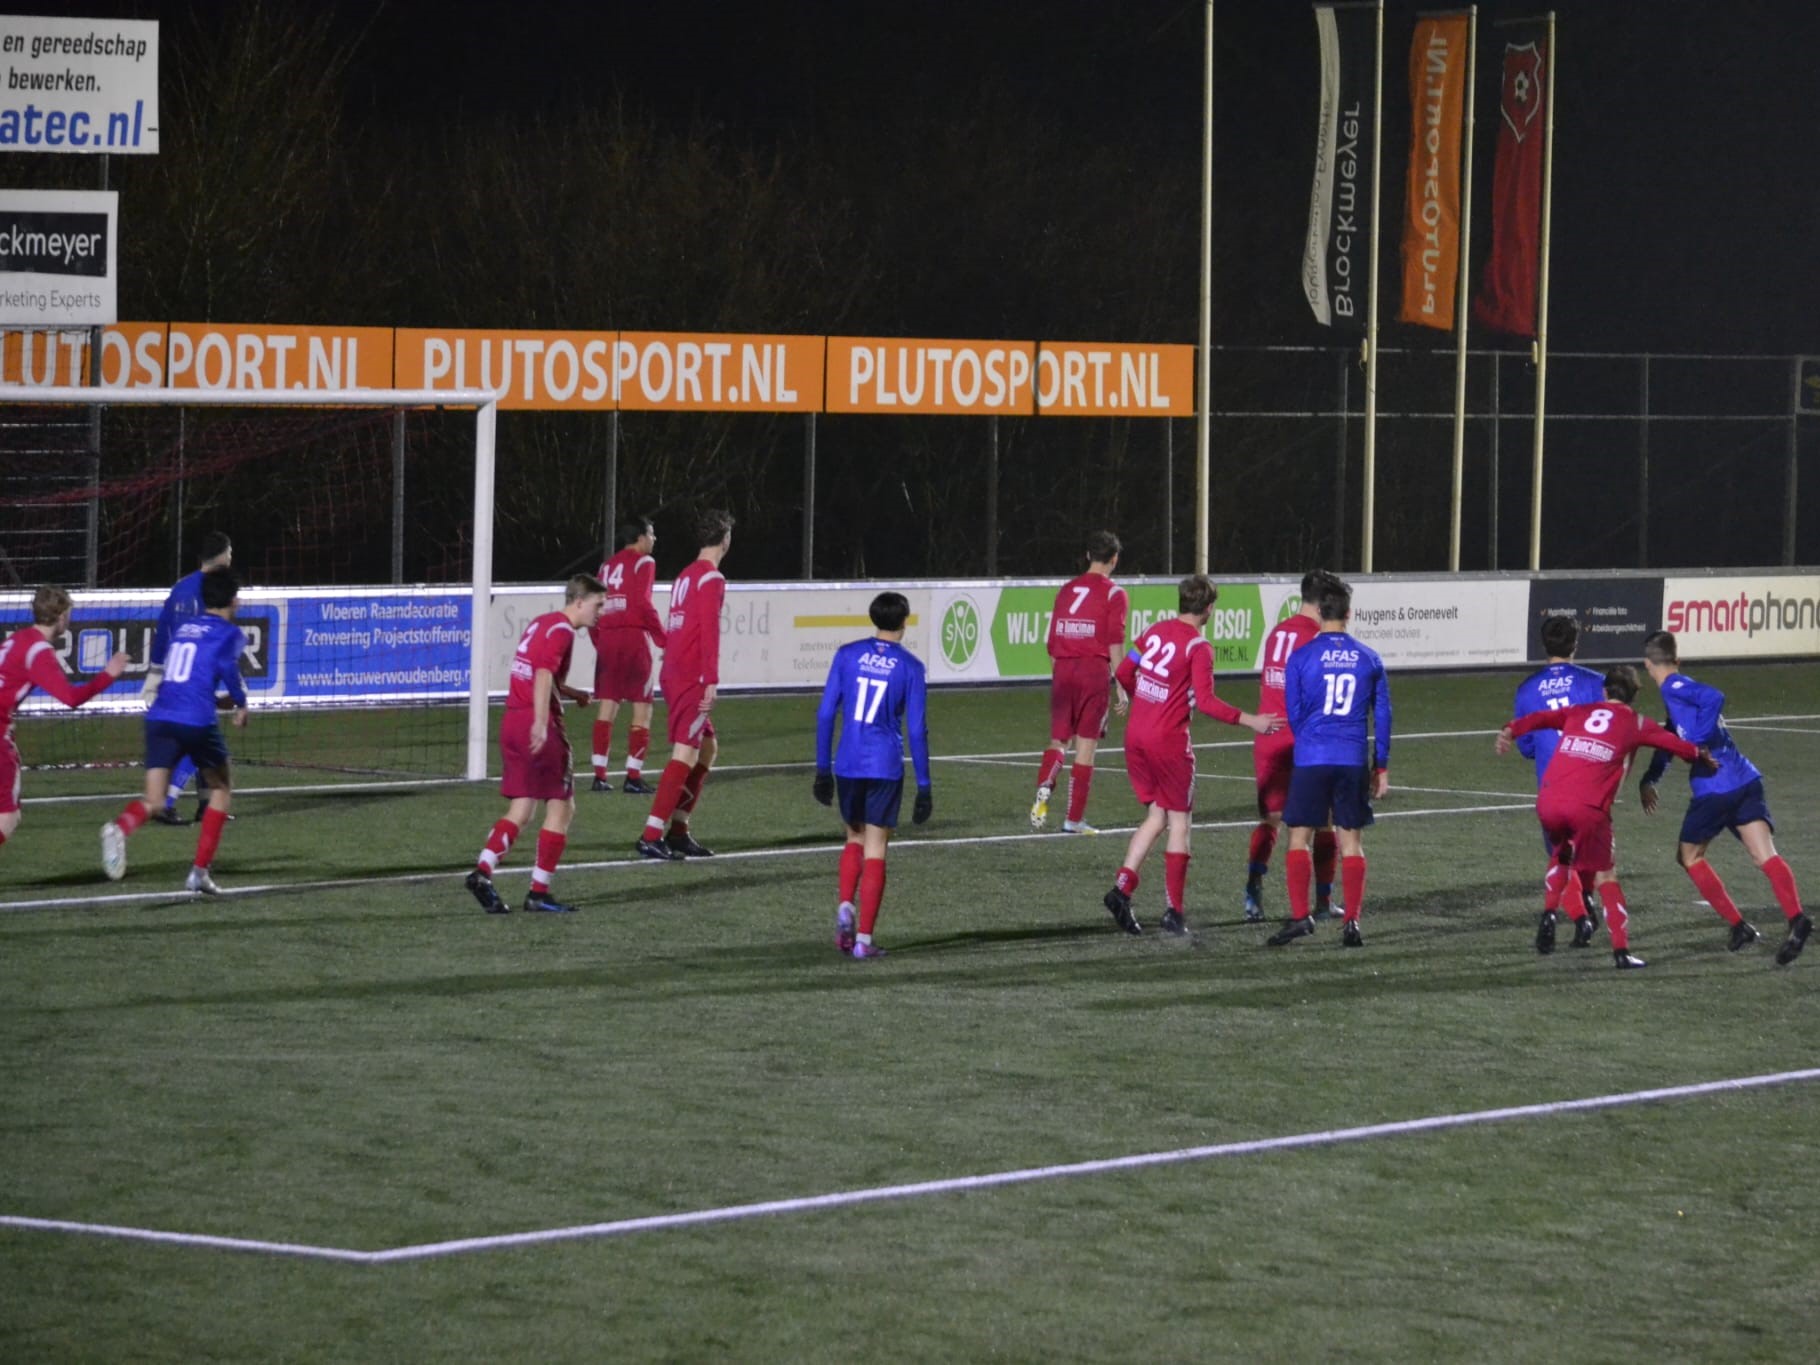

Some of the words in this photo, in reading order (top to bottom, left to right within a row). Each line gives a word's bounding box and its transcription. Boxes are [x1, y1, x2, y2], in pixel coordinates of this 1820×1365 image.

[3, 34, 25, 53] en
[31, 31, 147, 63] gereedschap
[8, 65, 101, 93] bewerken.
[0, 99, 144, 147] atec.nl
[50, 289, 101, 310] Experts
[424, 337, 798, 402] PLUTOSPORT.NL
[850, 346, 1170, 408] PLUTOSPORT.NL
[321, 602, 367, 620] Vloeren
[370, 600, 459, 619] Raamdecoratie
[1068, 586, 1090, 615] 7
[1007, 611, 1039, 644] WIJ
[1213, 608, 1252, 640] BSO!
[1355, 607, 1397, 626] Huygens
[1398, 607, 1405, 620] &
[1407, 605, 1459, 621] Groenevelt
[305, 628, 370, 649] Zonwering
[373, 625, 471, 648] Projectstoffering
[162, 643, 198, 683] 10
[857, 652, 899, 669] AFAS
[1139, 634, 1177, 678] 22
[1321, 650, 1360, 662] AFAS
[297, 667, 472, 687] www.brouwerwoudenberg.n
[1538, 675, 1574, 691] AFAS
[854, 676, 888, 724] 17
[1323, 673, 1357, 716] 19
[1584, 708, 1614, 734] 8
